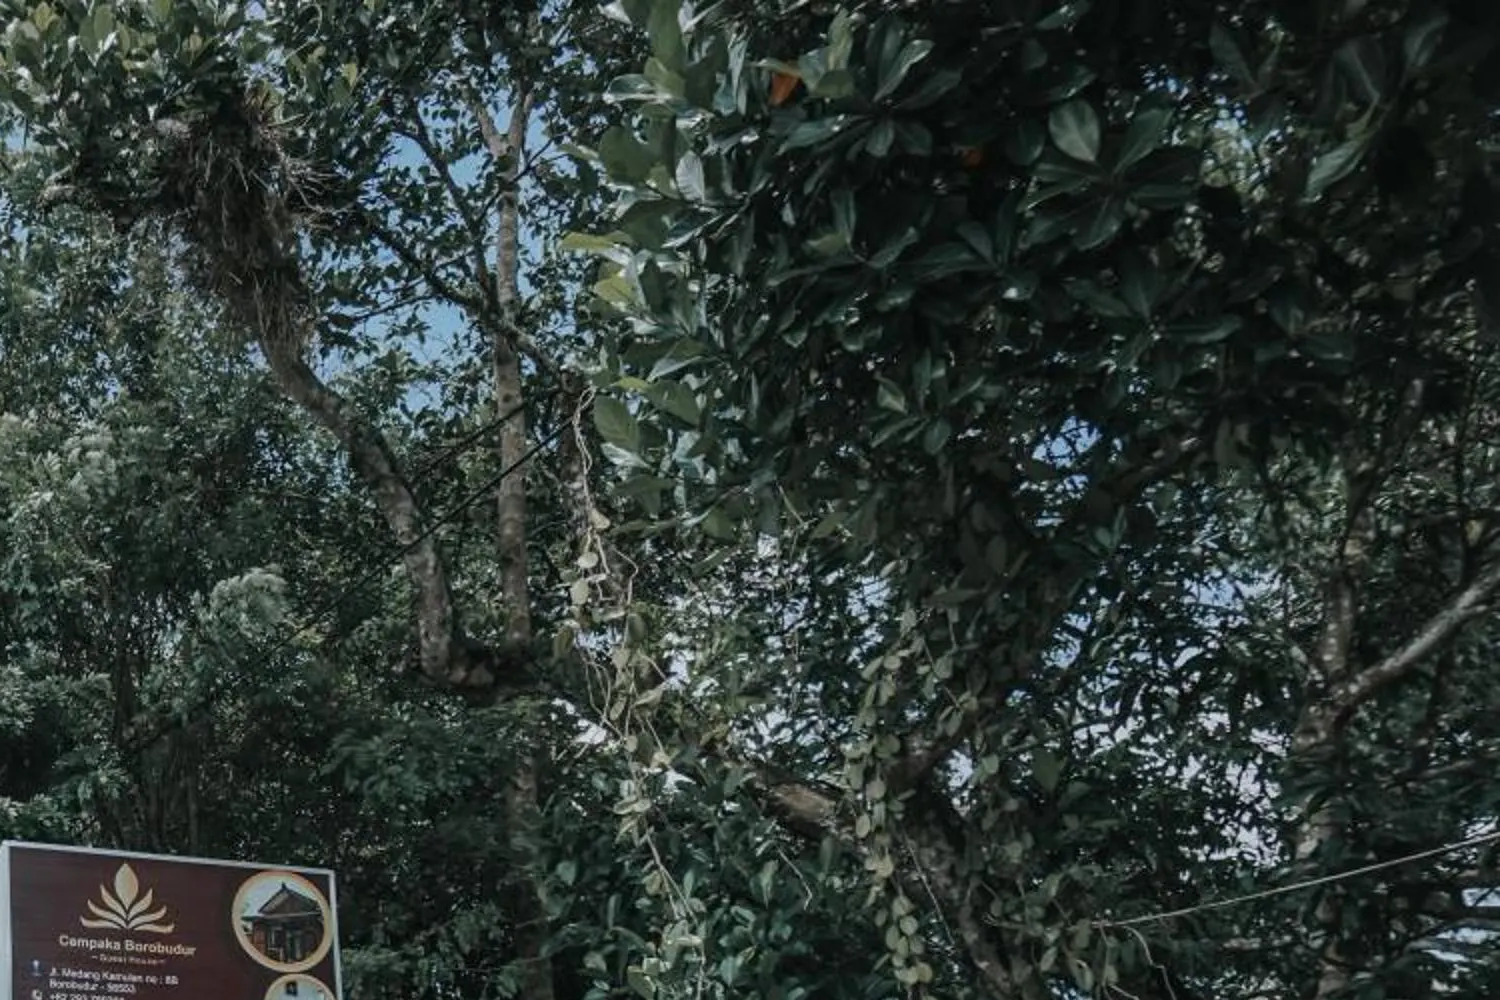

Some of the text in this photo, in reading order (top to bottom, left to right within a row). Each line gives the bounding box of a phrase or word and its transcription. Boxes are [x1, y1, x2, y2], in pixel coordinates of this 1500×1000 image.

[59, 935, 197, 956] Campaka Borobudur
[61, 967, 100, 981] Medang
[49, 978, 99, 991] Borobudur
